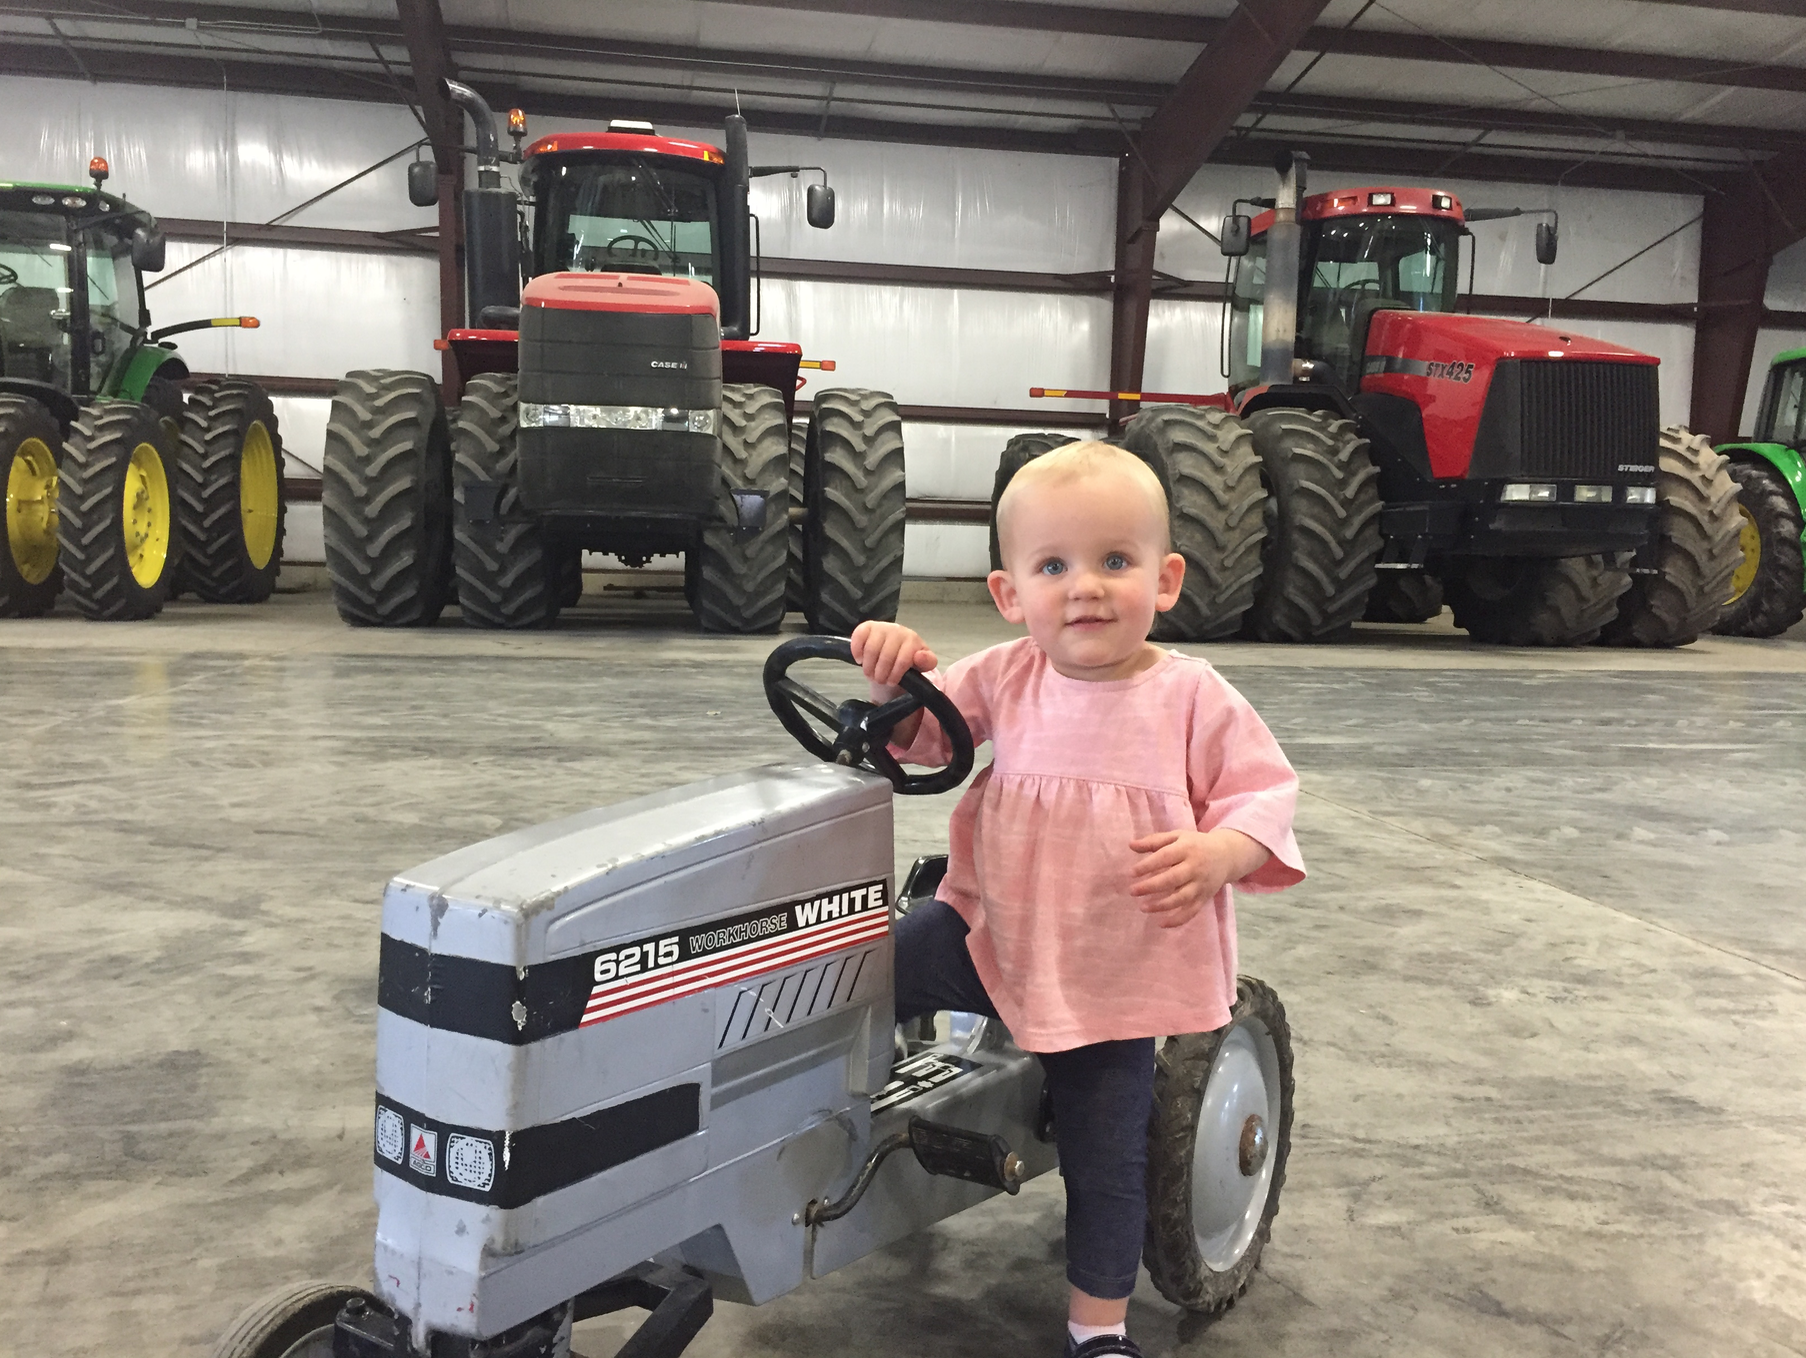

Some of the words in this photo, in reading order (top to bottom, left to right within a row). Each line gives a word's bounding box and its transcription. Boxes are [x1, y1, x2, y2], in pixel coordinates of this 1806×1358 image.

[651, 361, 678, 369] CASE
[1426, 361, 1474, 383] STX425
[594, 936, 679, 982] 6215
[690, 914, 787, 953] WORKHORSE
[795, 884, 884, 928] WHITE
